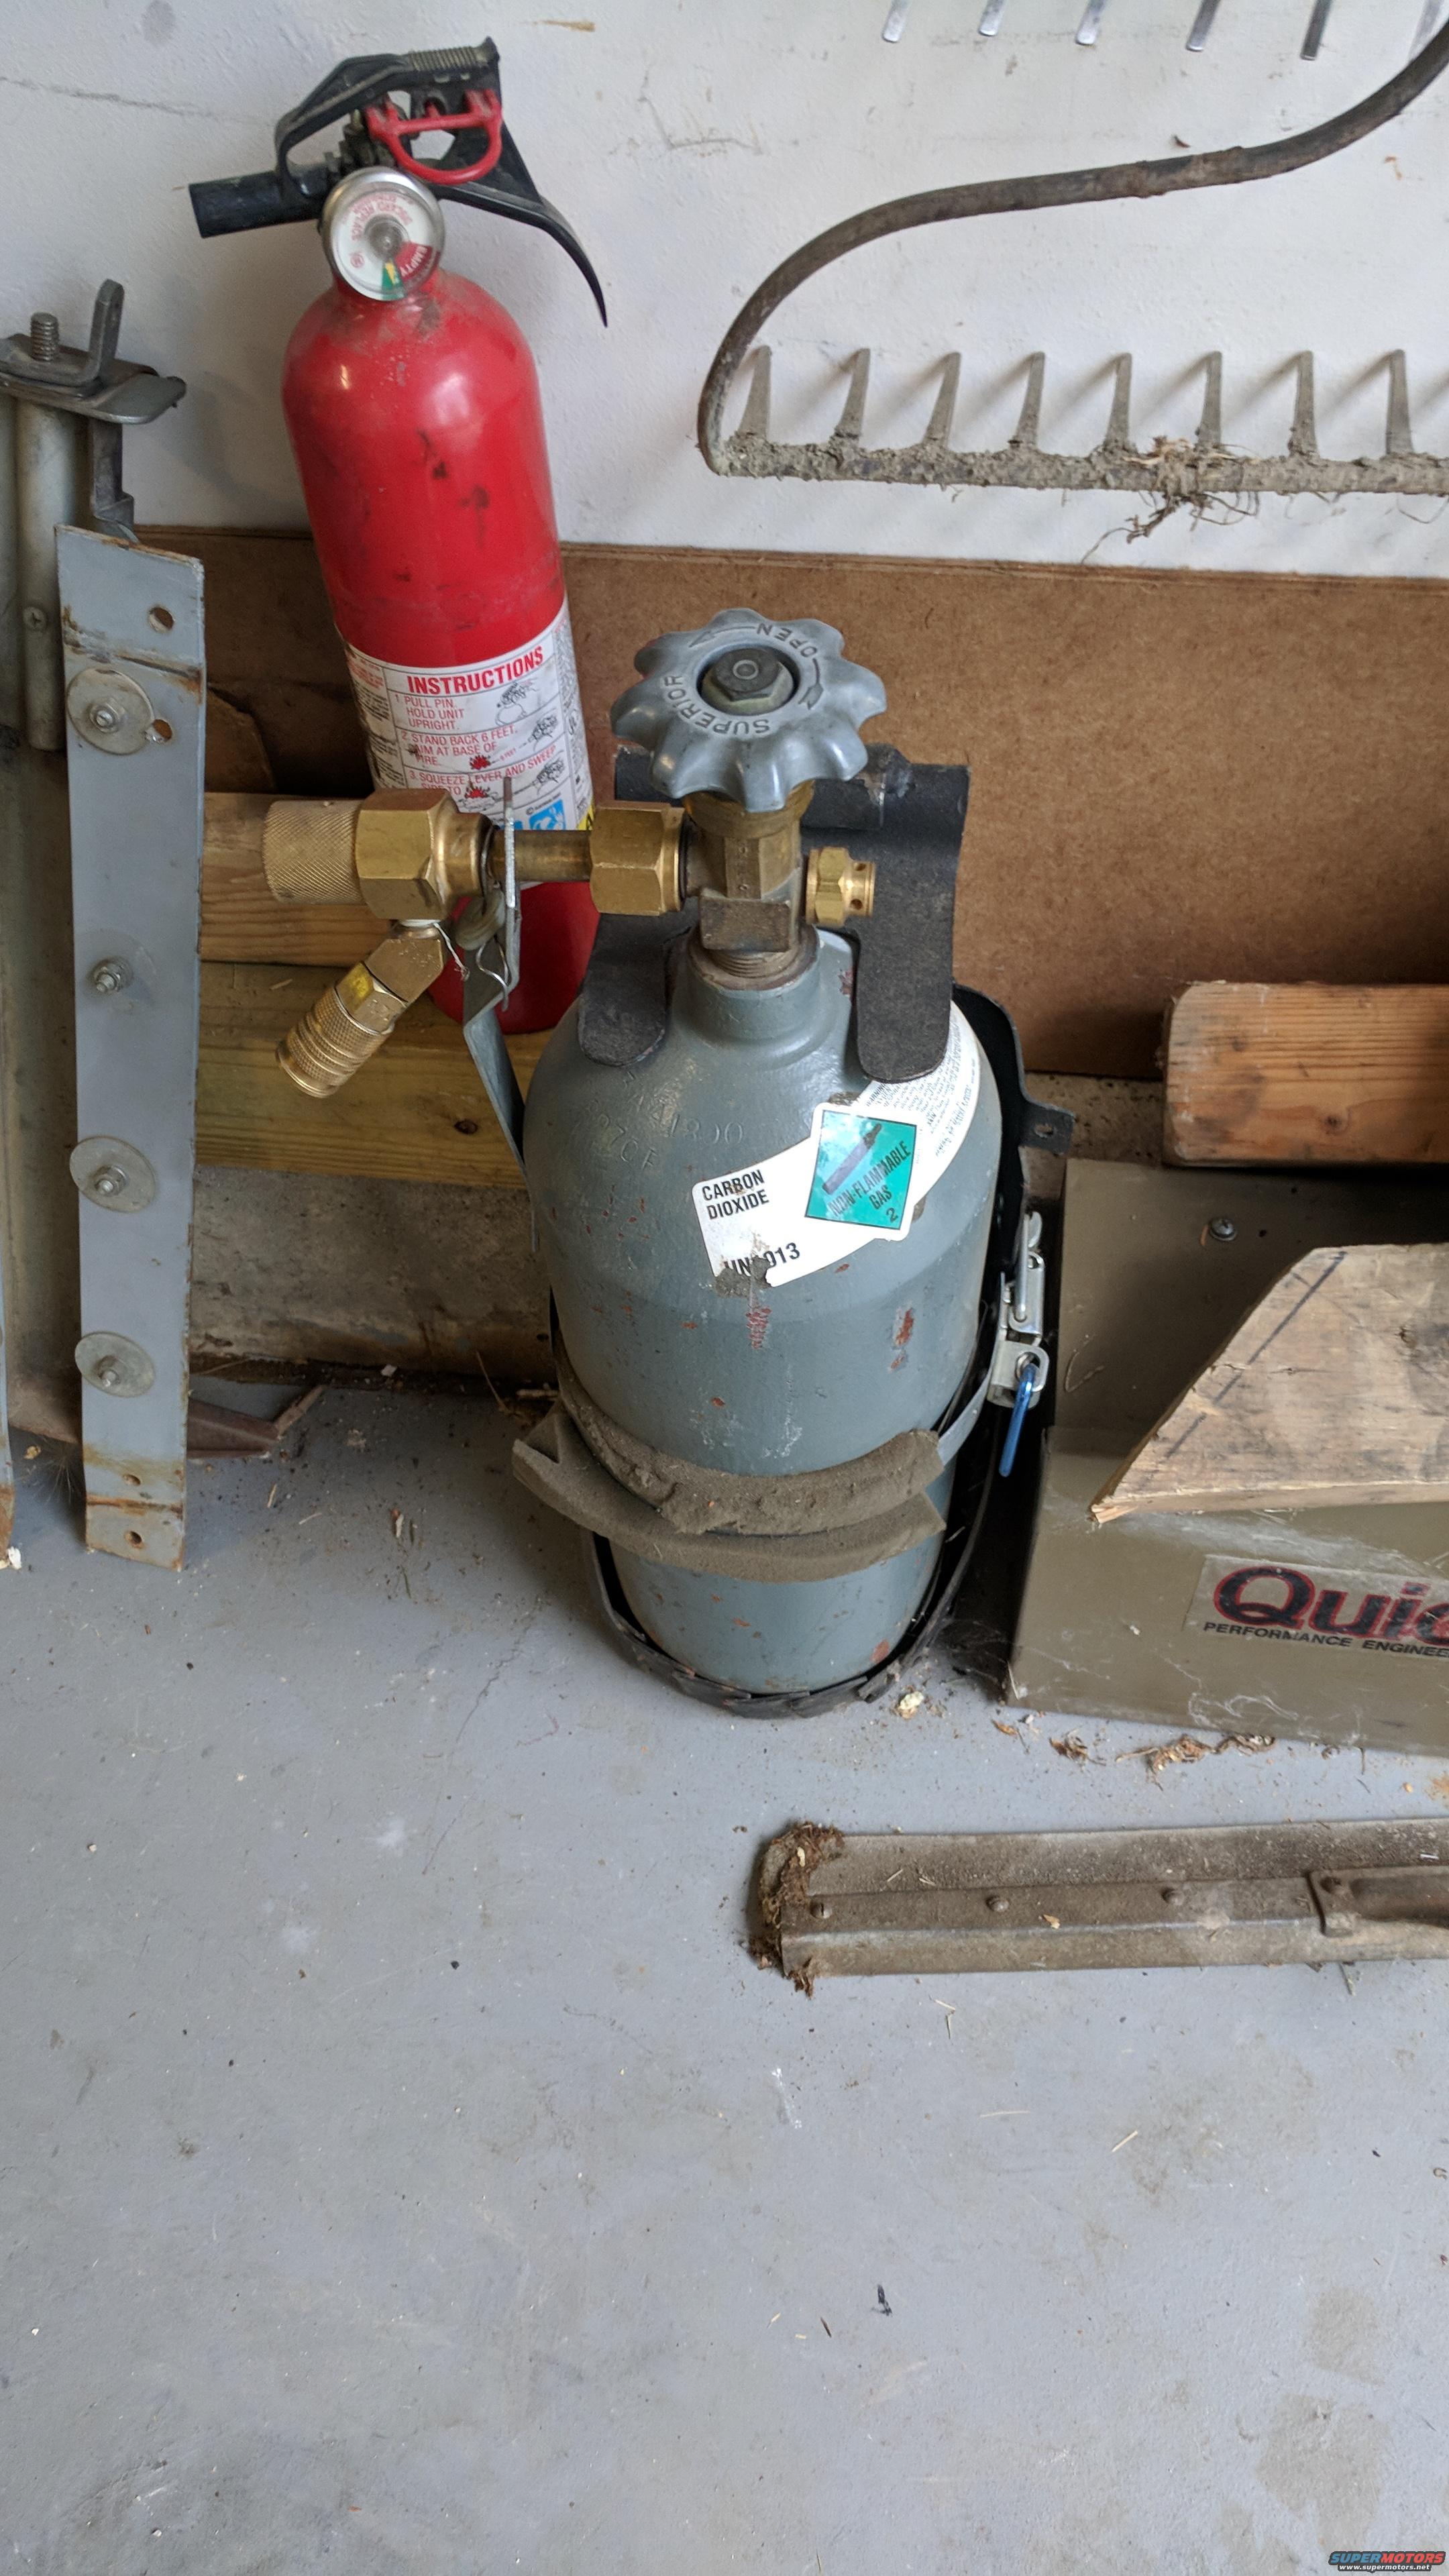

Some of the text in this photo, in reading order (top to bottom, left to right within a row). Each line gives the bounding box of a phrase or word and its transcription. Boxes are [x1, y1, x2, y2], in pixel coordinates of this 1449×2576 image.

[400, 245, 428, 278] EMPTY
[756, 623, 818, 658] OPEN
[407, 646, 544, 695] INSTRUCTIONS
[404, 696, 432, 708] PULL
[406, 706, 465, 719] HOLD UNIT
[663, 674, 771, 735] SUPERIOR
[411, 733, 447, 746] STAND
[449, 734, 480, 746] BACK
[482, 733, 489, 742] 6
[491, 724, 519, 740] FEET.
[414, 741, 499, 757] AIM AT BASE OF
[419, 771, 466, 785] SQUEEZE
[505, 763, 526, 777] AND
[527, 744, 556, 769] SWEEP
[702, 1169, 765, 1201] CARBON
[827, 1140, 911, 1217] NON-FLAMMABLE
[706, 1189, 770, 1220] DIOXIDE
[869, 1185, 893, 1210] GAS
[885, 1207, 899, 1224] 2
[1203, 1621, 1353, 1648] PERFORMANCE
